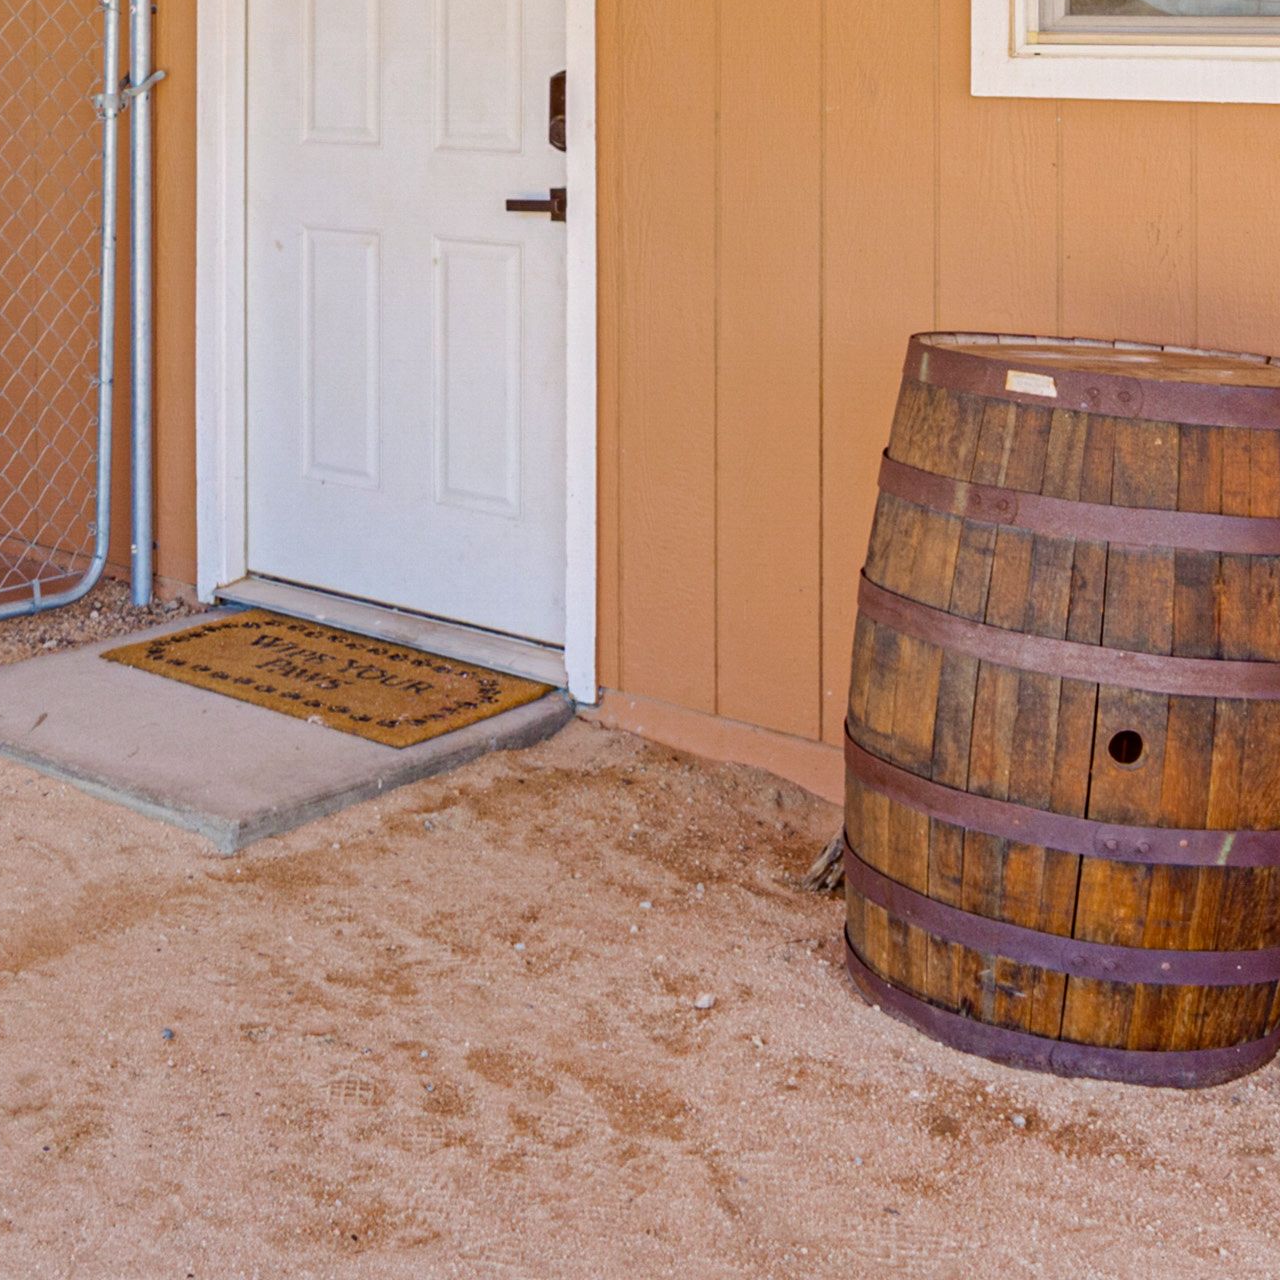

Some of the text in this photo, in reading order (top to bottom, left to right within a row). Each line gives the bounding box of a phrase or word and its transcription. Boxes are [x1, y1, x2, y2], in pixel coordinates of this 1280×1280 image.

[251, 634, 434, 695] WIPE YOUR
[255, 657, 354, 690] PAWS
